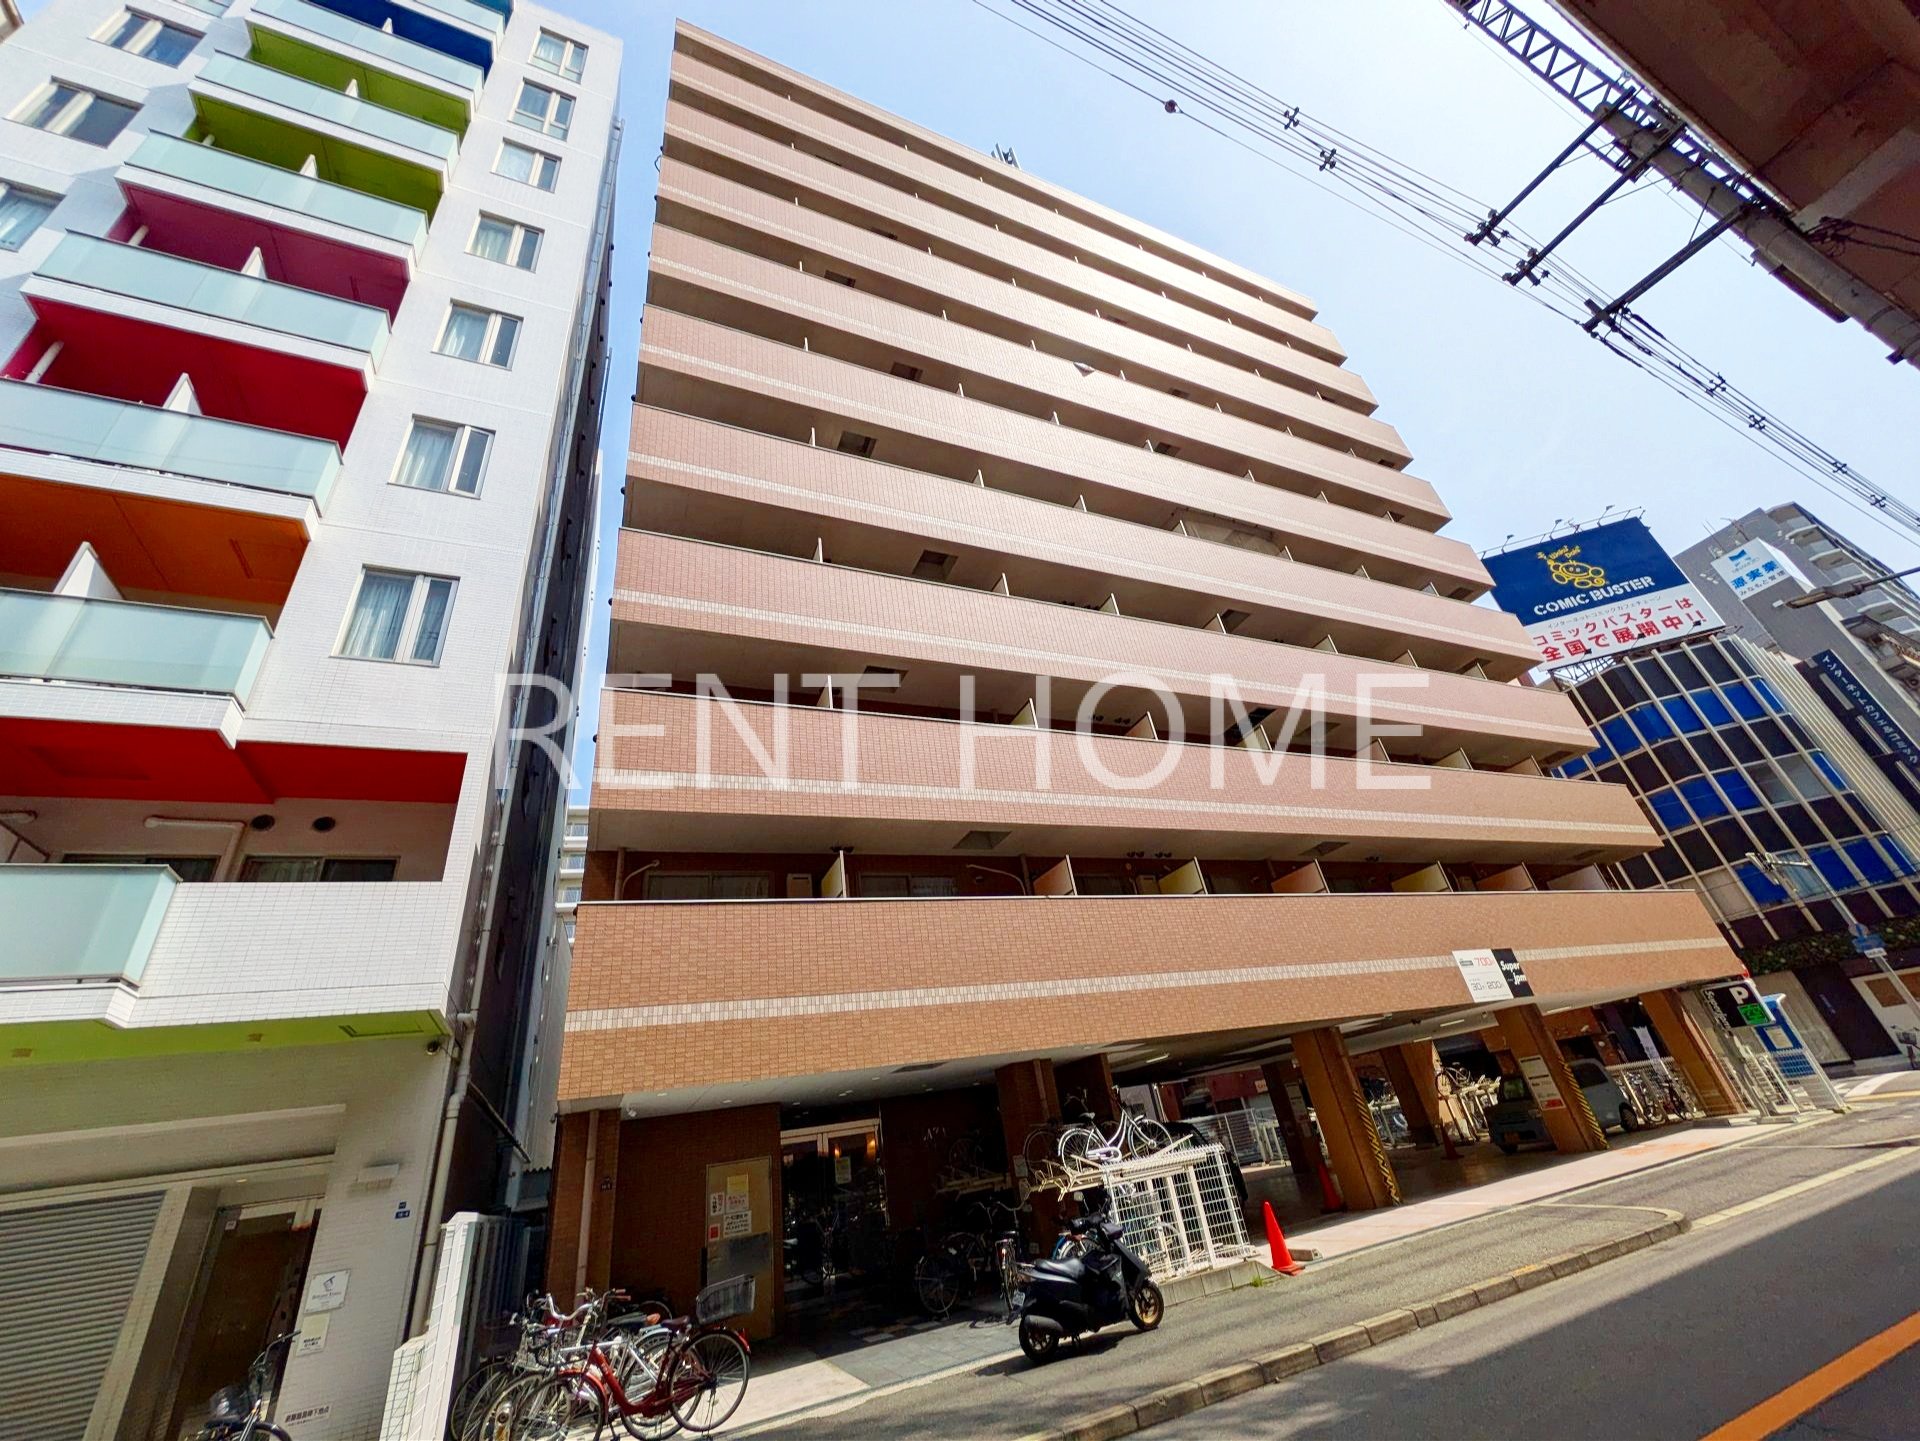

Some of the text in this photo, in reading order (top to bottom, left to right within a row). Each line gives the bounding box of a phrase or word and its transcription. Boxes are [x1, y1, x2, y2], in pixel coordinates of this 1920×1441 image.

[1533, 575, 1656, 616] COMIC BUSTER
[1533, 597, 1694, 647] コミックバスターは
[1500, 960, 1520, 973] Super
[1729, 986, 1749, 1004] P
